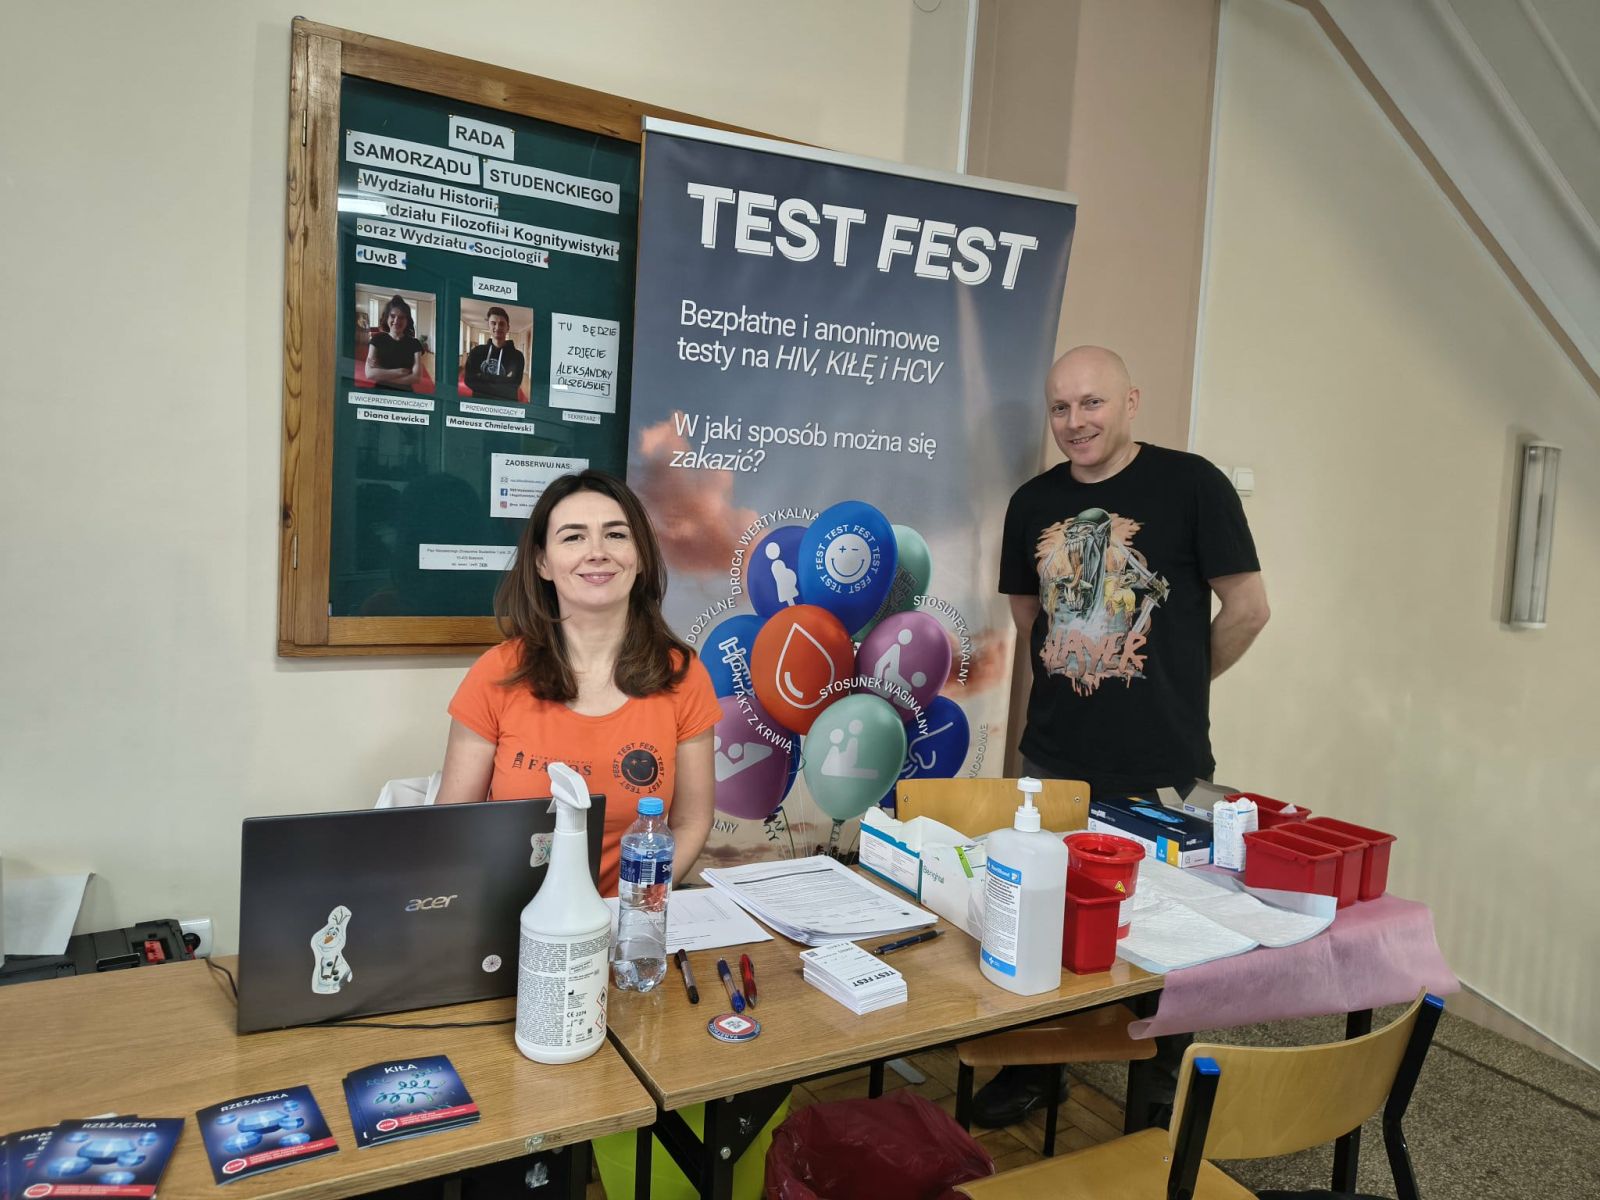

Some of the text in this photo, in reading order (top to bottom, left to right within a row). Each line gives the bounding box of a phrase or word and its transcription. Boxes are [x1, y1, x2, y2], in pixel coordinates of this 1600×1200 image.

[456, 125, 505, 149] RADA
[354, 142, 613, 204] SAMORZĄDU STUDENCKIEGO
[363, 172, 434, 198] Wydziału
[364, 223, 541, 264] oraz Wydziału Socjologii
[387, 206, 436, 224] działu
[442, 211, 498, 235] Filozofii
[514, 228, 614, 258] Kognitywistyki
[687, 182, 1038, 290] TEST FEST
[364, 249, 397, 264] UwB
[478, 283, 512, 296] ZARZĄD
[558, 322, 617, 337] TU BĘDZIE
[680, 299, 940, 352] Bezpłatne i anonimowe
[567, 346, 607, 359] ZDJĘCIE
[677, 337, 945, 385] testy na HIV, KIŁĘ i HCV
[556, 362, 613, 379] ALEKSANDRY
[363, 412, 426, 424] Diana Lewicka
[450, 418, 533, 432] Mateusz Chmielewski
[674, 412, 938, 459] W jaki sposób można się
[505, 459, 554, 468] ZAOBSERWUJ
[669, 445, 766, 473] zakazić?
[730, 508, 820, 596] DROGA WERTYKALNA
[816, 524, 880, 594] TEST FEST TEST FEST TEST FEST
[686, 597, 736, 645] DOŻYLNE
[913, 595, 970, 688] STOSUNEK ANALNY
[819, 677, 929, 736] STOSUNEK WAGINALNY
[747, 714, 759, 725] Z
[755, 722, 792, 753] KRWIĄ
[405, 894, 458, 911] acer
[853, 970, 896, 987] TEST FEST
[384, 1064, 418, 1074] KIŁA
[220, 1093, 289, 1112] RZEŻĄCZKA
